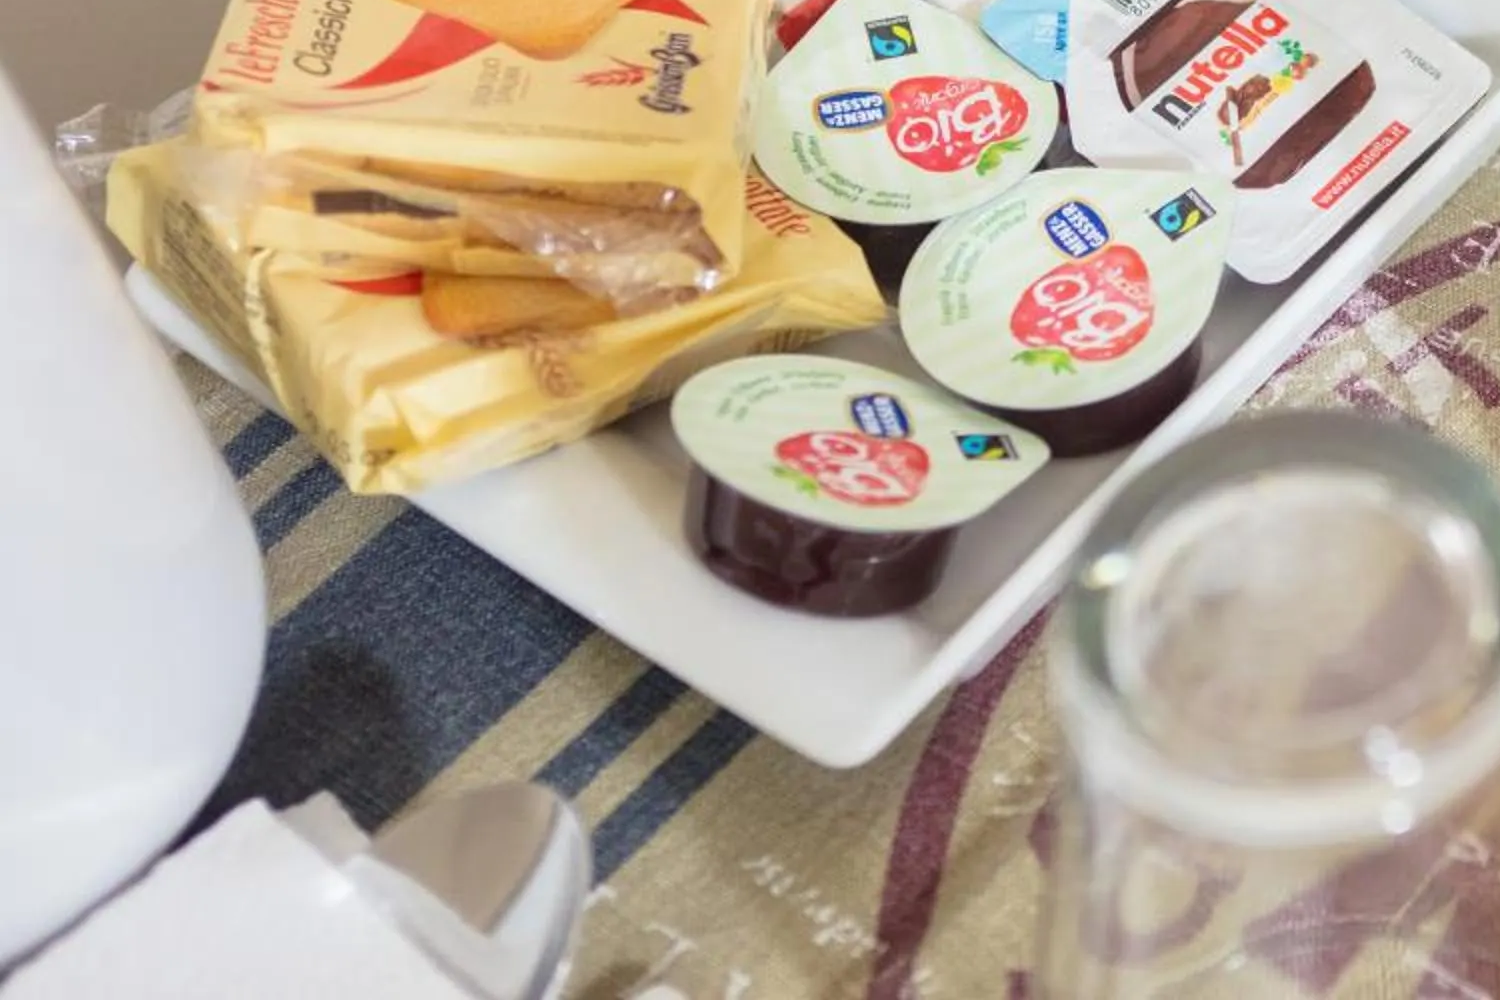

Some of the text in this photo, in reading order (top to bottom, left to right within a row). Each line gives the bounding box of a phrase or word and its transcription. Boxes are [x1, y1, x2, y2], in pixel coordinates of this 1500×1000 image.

[1150, 4, 1291, 128] nutella
[818, 94, 884, 116] GASSER
[1061, 201, 1106, 249] GASSER
